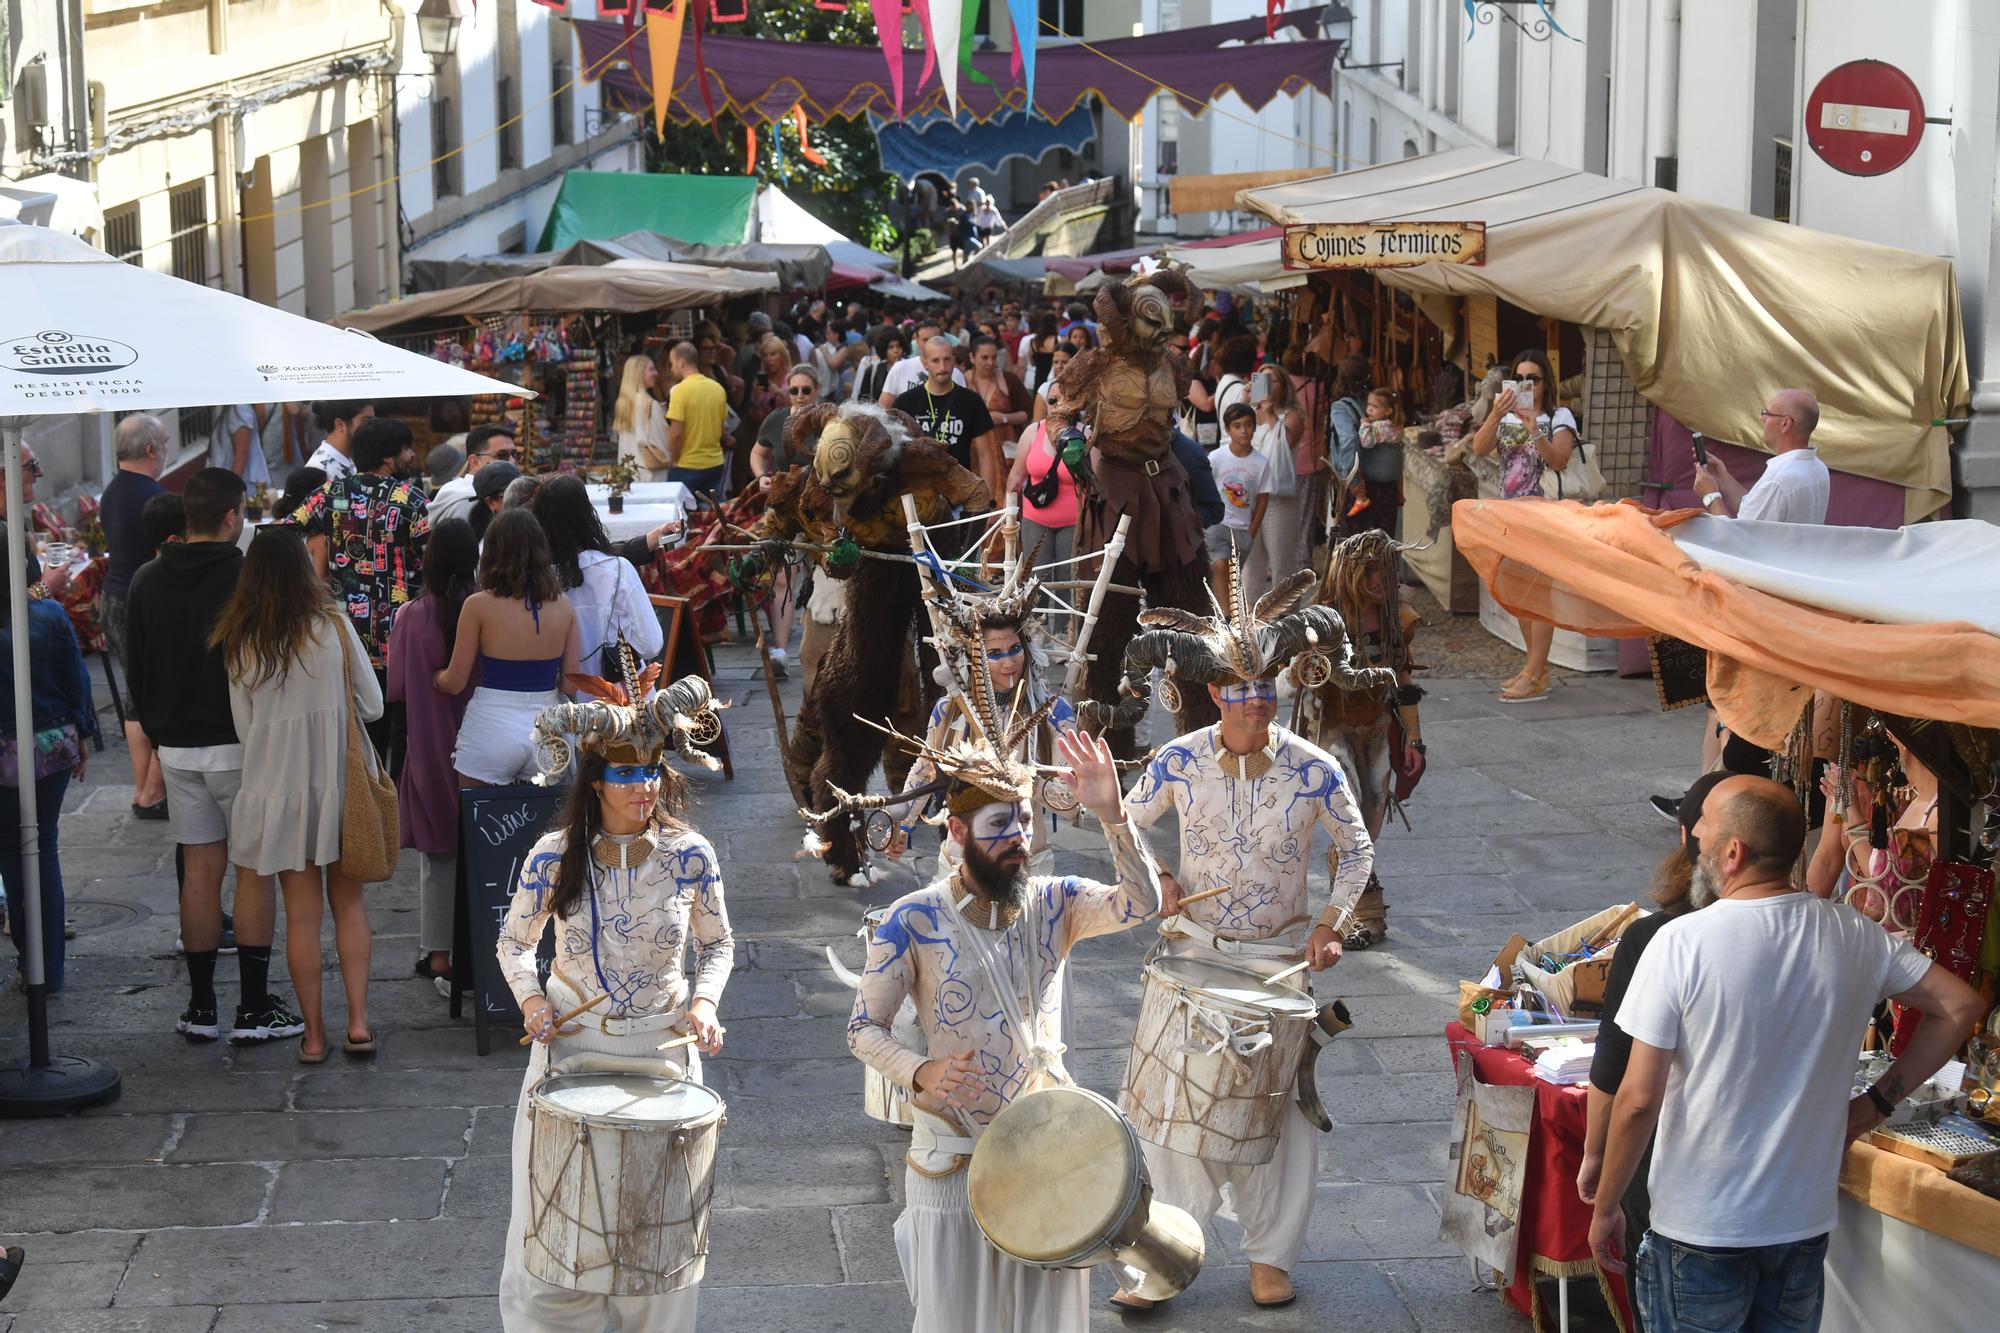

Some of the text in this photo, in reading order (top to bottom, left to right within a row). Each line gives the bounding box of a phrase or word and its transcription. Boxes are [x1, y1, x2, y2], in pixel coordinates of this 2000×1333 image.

[1299, 228, 1463, 262] Cojines Termicos
[13, 344, 111, 356] Estrella
[20, 354, 112, 366] Galicia
[14, 379, 144, 389] RESISTENCIA
[25, 387, 141, 398] DESDE 1906
